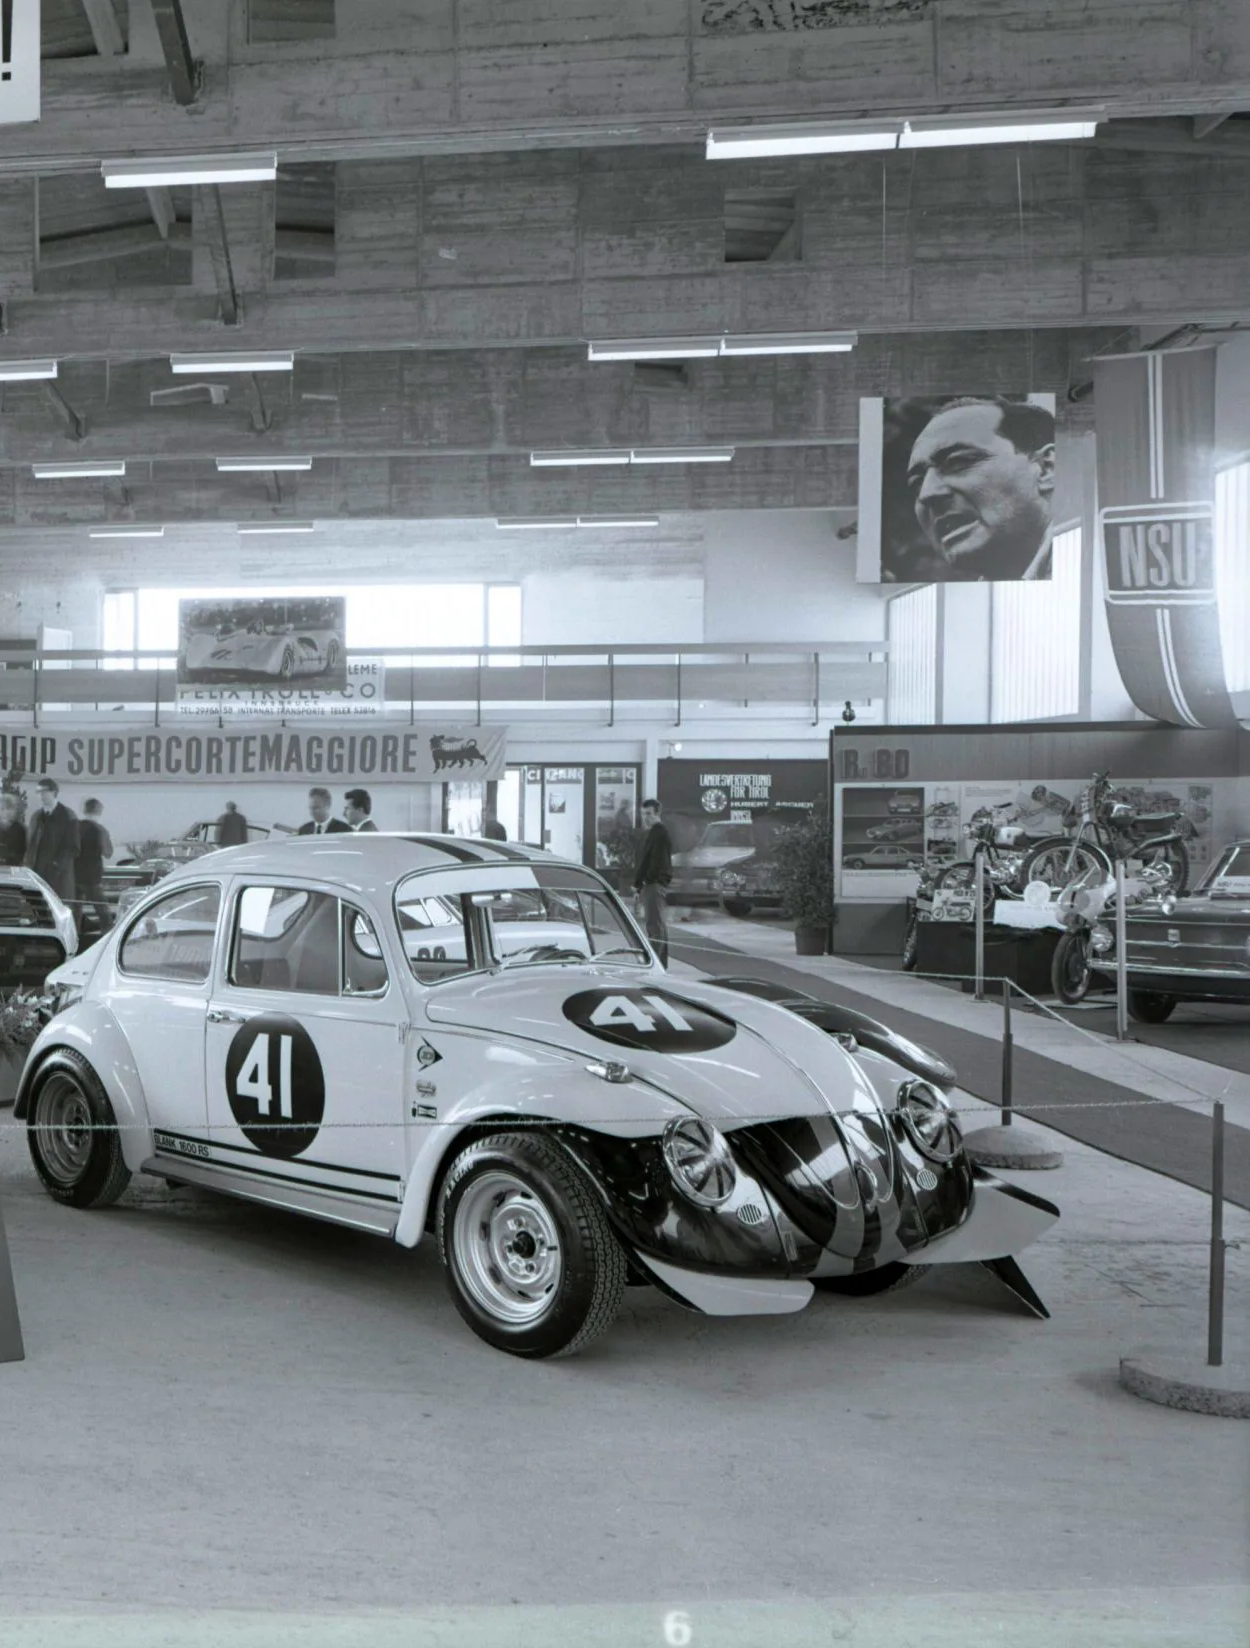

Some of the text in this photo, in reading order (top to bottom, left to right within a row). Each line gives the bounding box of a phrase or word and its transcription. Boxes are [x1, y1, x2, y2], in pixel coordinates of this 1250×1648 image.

[1118, 521, 1198, 588] NSU
[67, 733, 418, 776] SUPERCORTEMAGGIORE
[874, 748, 910, 779] 80
[589, 994, 694, 1032] 41
[236, 1032, 293, 1118] 41
